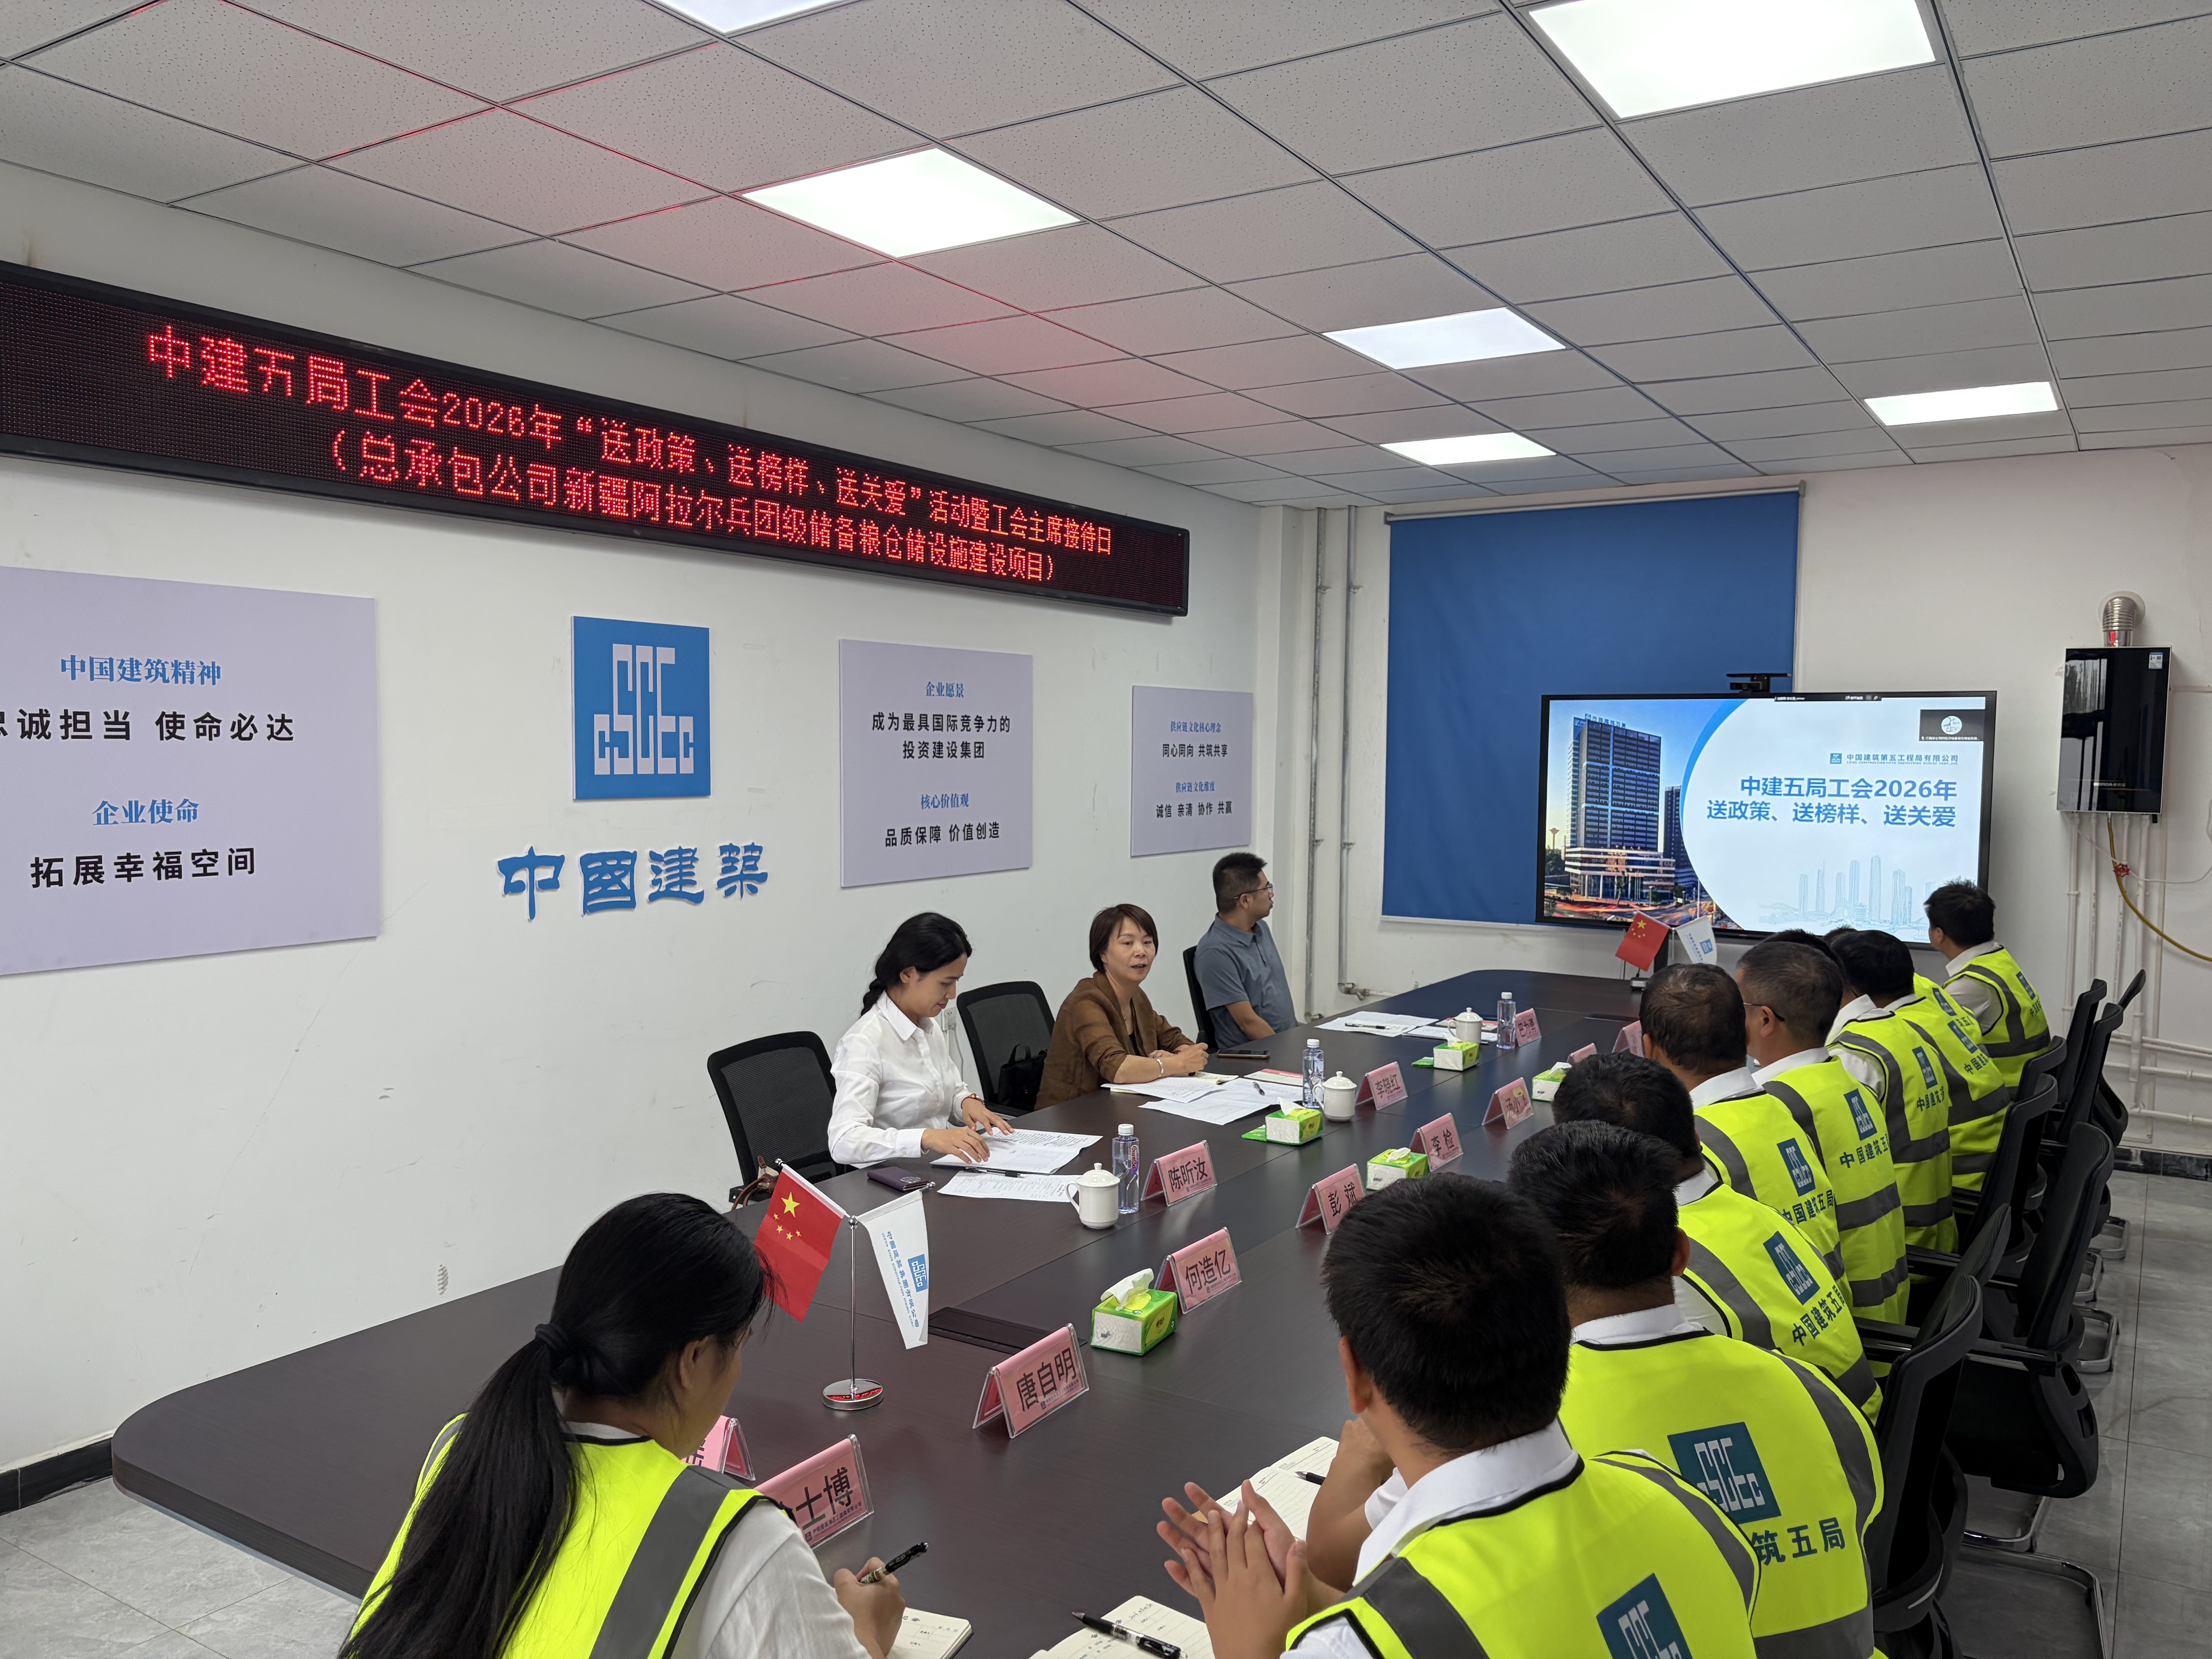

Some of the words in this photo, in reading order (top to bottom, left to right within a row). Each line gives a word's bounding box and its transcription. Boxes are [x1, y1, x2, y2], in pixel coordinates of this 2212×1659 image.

[60, 654, 222, 685] 中国建筑精神
[925, 681, 964, 698] 企业愿景
[0, 709, 131, 741] 诚担当
[155, 711, 294, 741] 使命必达
[872, 711, 1011, 733] 成为最具国际竞争力的
[1170, 720, 1221, 733] 供应链文化核心理念
[902, 741, 985, 760] 投资建设集团
[1162, 744, 1194, 758] 同心同向
[1198, 743, 1228, 757] 共筑共享
[1176, 781, 1215, 792] 供应链文化维度
[1740, 776, 1957, 801] 中建五局工会2026年
[92, 798, 199, 826] 企业使命
[921, 792, 969, 810] 核心价值观
[1156, 804, 1172, 818] 诚信
[1177, 802, 1193, 817] 亲清
[1198, 801, 1213, 816] 协作
[1218, 800, 1232, 815] 共赢
[1706, 799, 1956, 828] 送政策、送榜样、送关爱
[885, 824, 942, 848] 品质保障
[948, 821, 1000, 843] 价值创造
[31, 847, 256, 888] 拓展幸福空间
[1375, 1074, 1401, 1099] 李晓红
[1431, 1128, 1455, 1156] 李检
[1168, 1157, 1208, 1192] 陈昕汝
[1185, 1249, 1231, 1295] 何造亿
[1016, 1347, 1077, 1412] 唐自明
